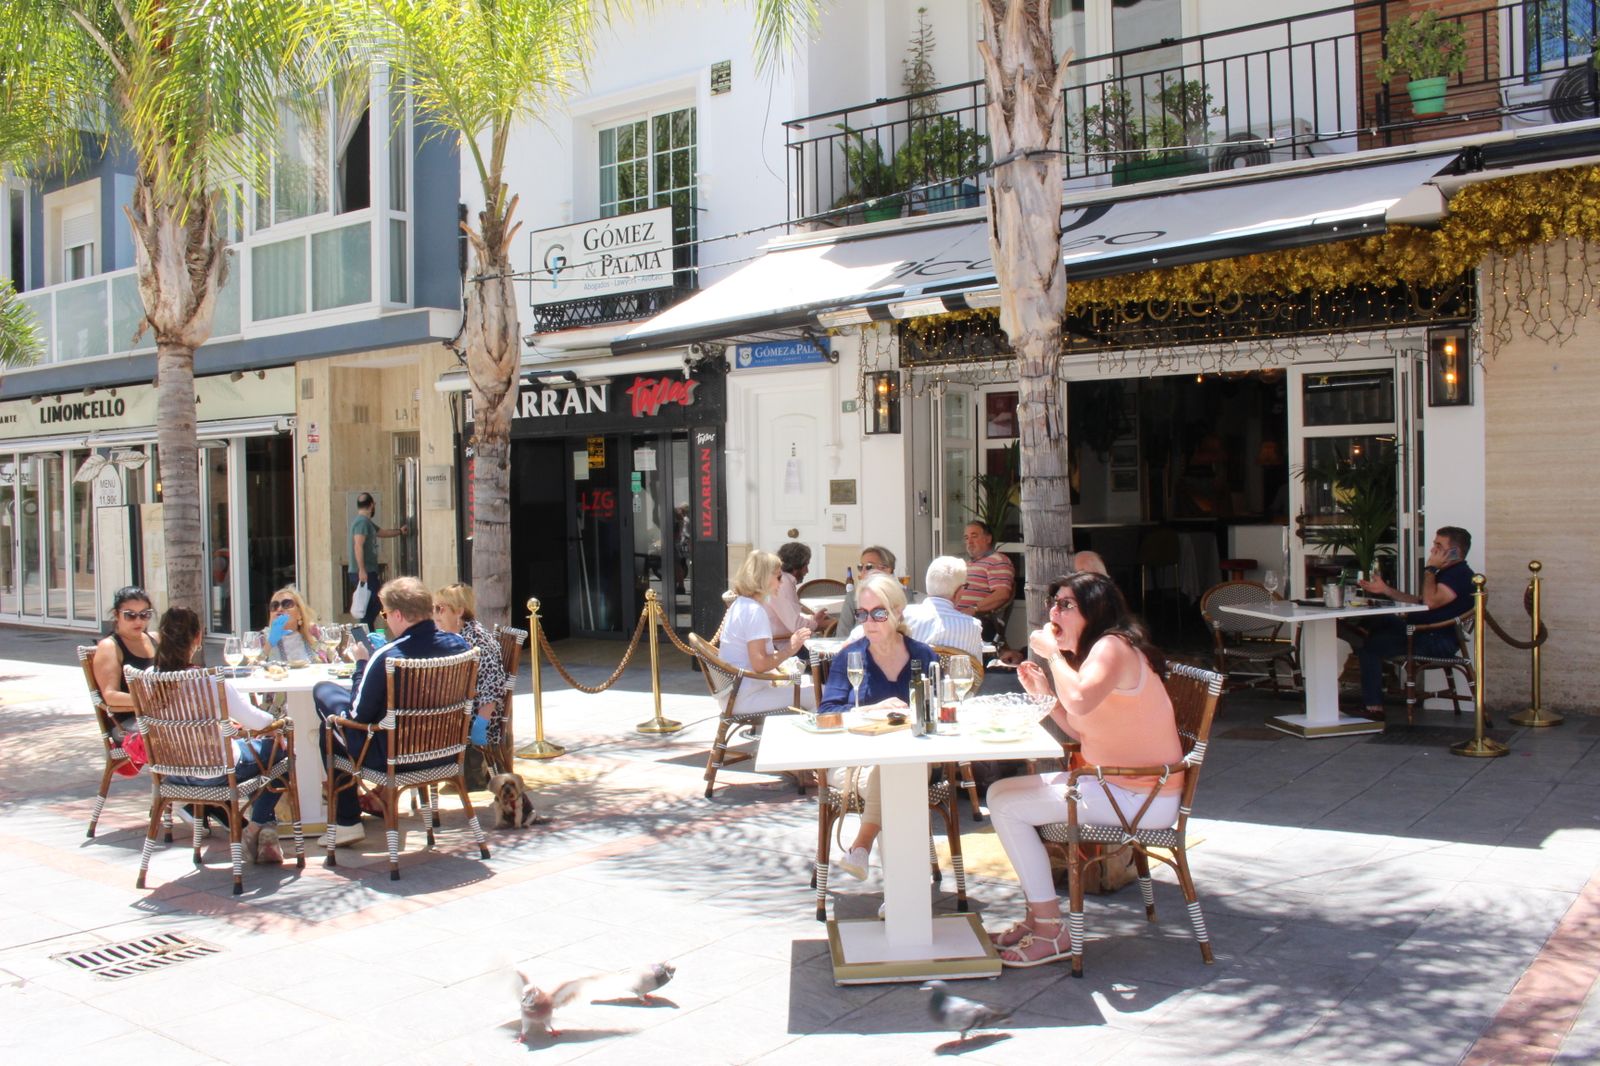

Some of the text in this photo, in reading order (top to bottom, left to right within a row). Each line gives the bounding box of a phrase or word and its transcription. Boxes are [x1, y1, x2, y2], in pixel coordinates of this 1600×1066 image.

[583, 222, 655, 251] GÓMEZ
[600, 251, 662, 277] PALMA
[40, 398, 125, 424] LIMONCELLO
[701, 448, 713, 537] LIZARRAN
